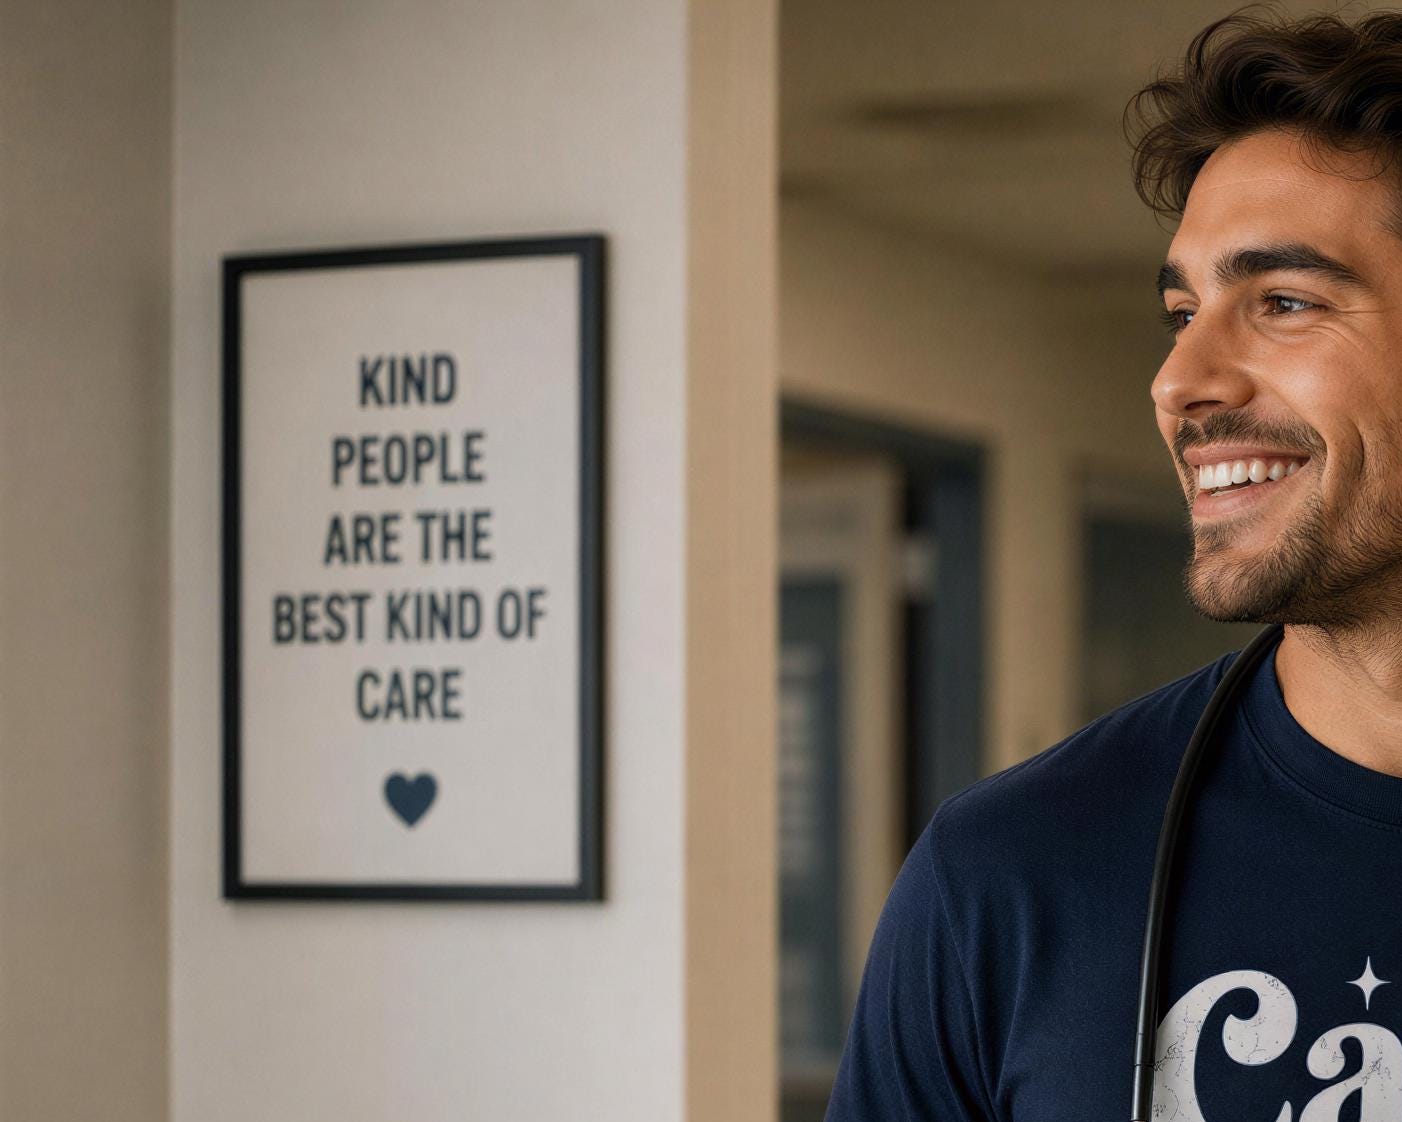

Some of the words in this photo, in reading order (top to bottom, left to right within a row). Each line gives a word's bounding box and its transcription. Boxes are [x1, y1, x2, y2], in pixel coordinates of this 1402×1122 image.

[358, 353, 457, 408] KIND
[331, 431, 485, 487] PEOPLE
[323, 513, 401, 566] ARE
[414, 510, 493, 563] THE
[272, 592, 371, 645] BEST
[386, 590, 482, 642] KIND
[496, 587, 547, 641] OF
[355, 669, 463, 722] CARE
